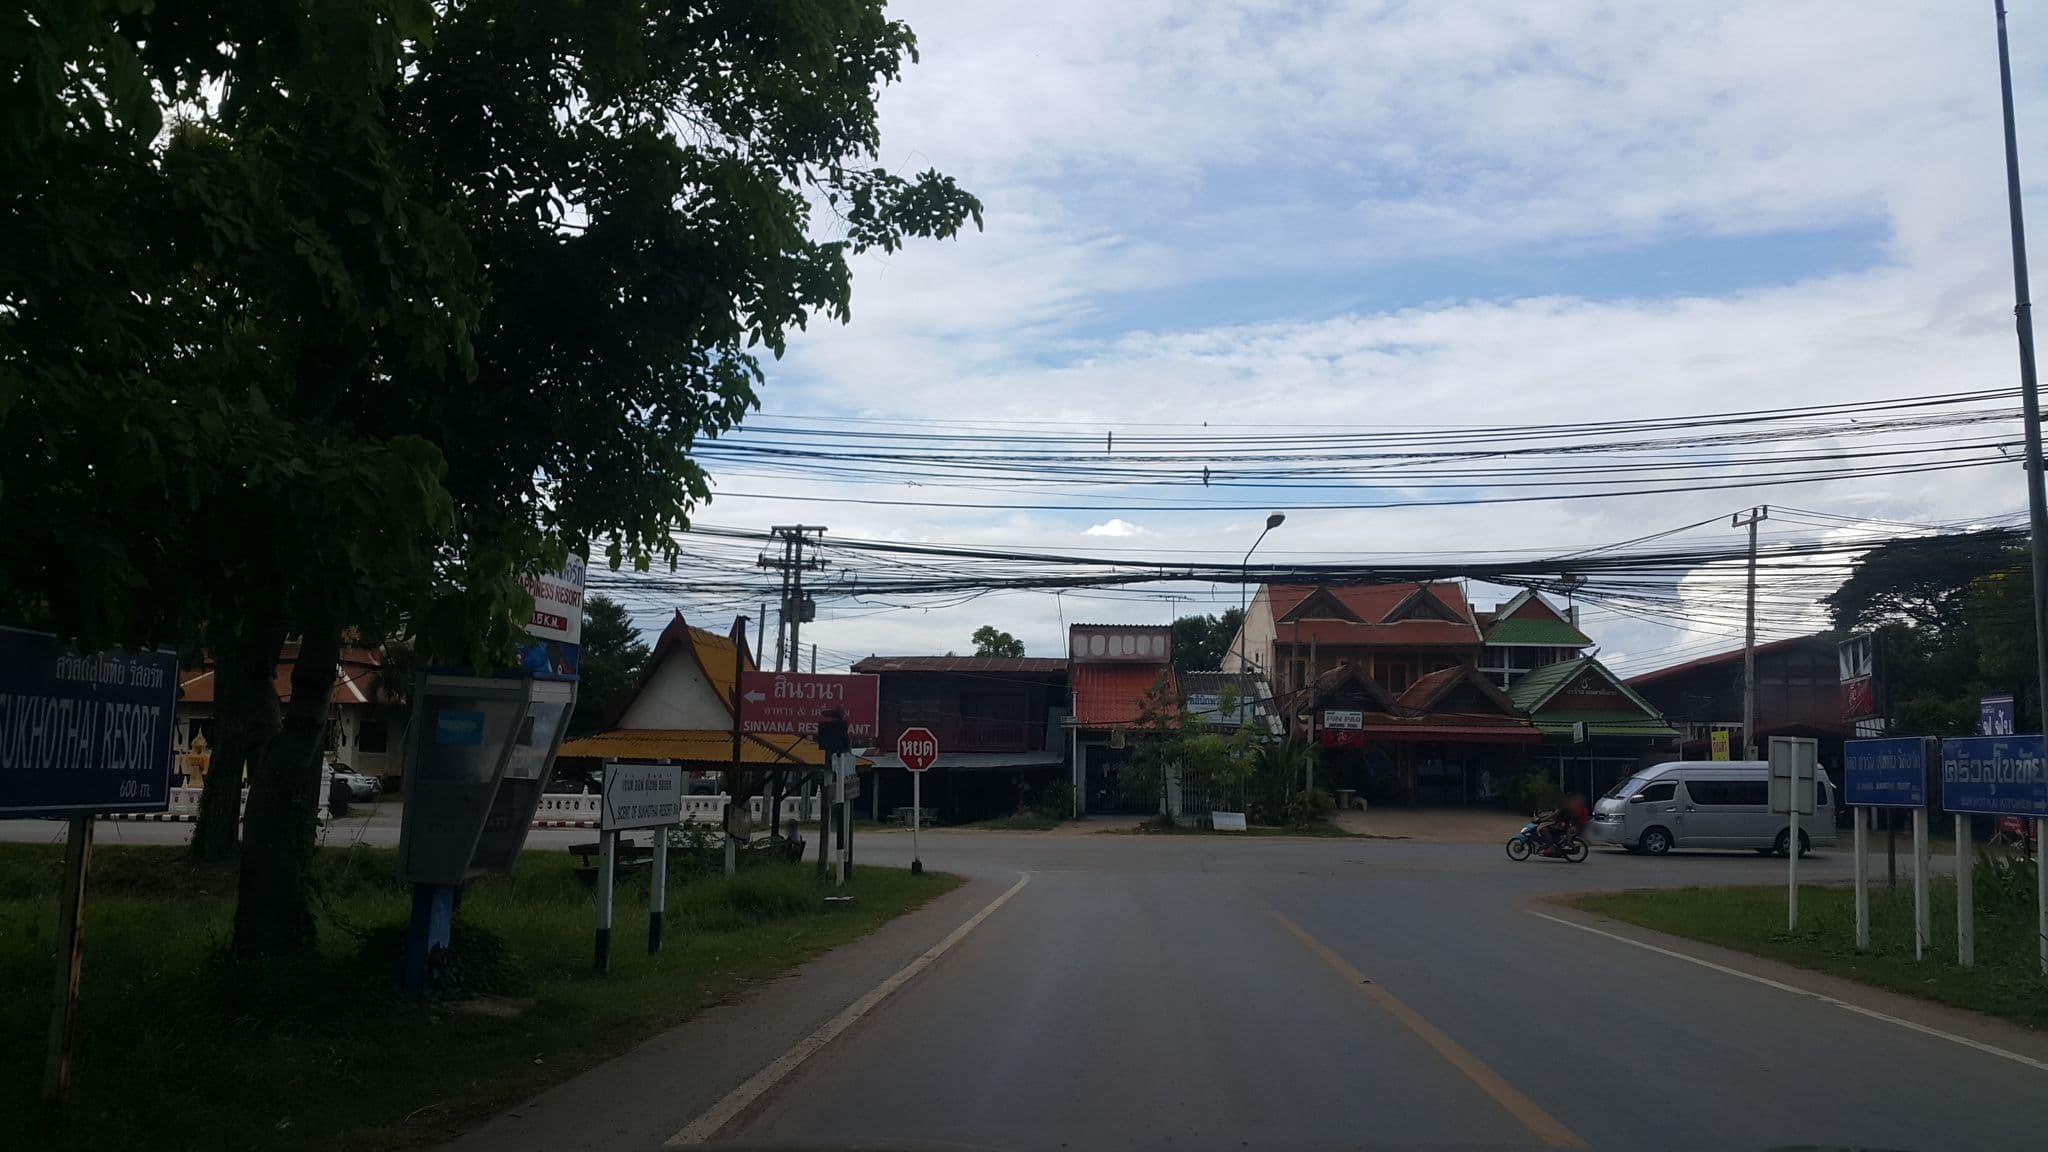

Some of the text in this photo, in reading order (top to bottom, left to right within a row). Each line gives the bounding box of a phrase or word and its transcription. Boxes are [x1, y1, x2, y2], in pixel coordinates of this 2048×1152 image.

[555, 585, 581, 608] RESORT
[773, 674, 845, 701] สินวนา
[797, 707, 807, 716] &
[101, 701, 160, 770] RESORT
[743, 720, 871, 735] SINVANA RESANT
[902, 740, 933, 767] หยุด
[120, 779, 137, 798] 600
